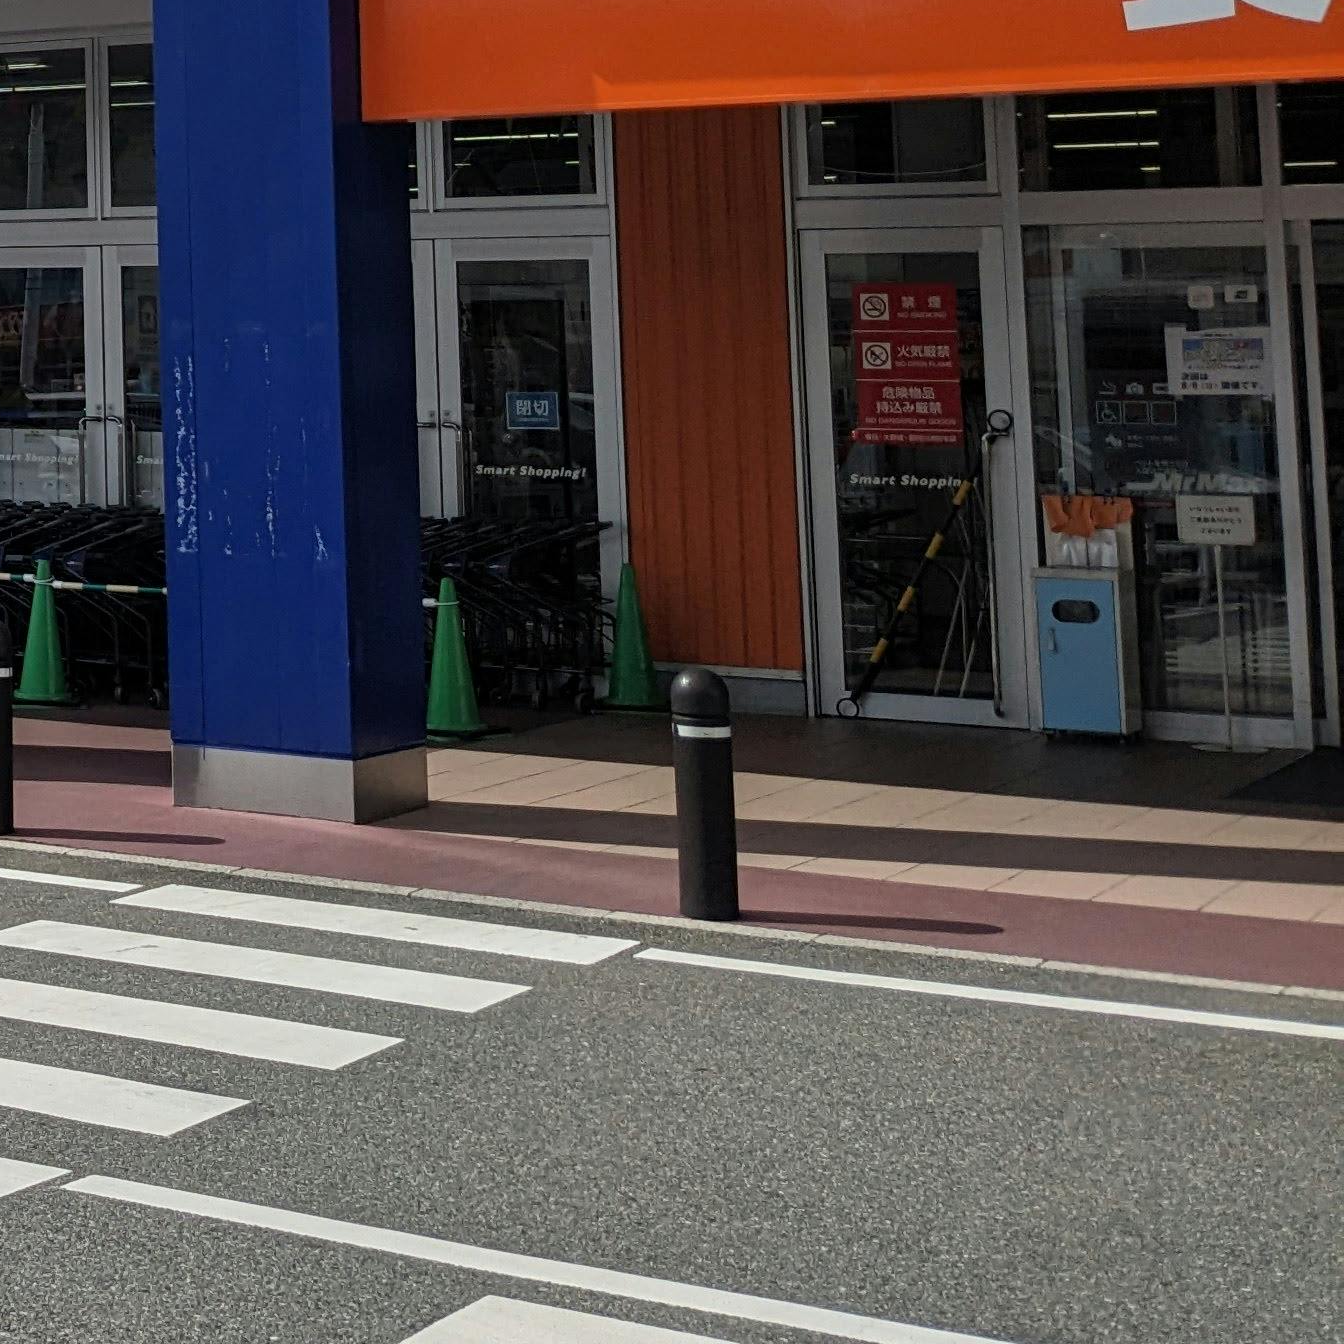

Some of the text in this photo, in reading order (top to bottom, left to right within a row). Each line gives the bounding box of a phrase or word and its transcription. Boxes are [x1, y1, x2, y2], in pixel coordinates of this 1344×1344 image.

[475, 465, 587, 480] Smart Shopping!
[849, 473, 978, 489] Smart Shoppin!
